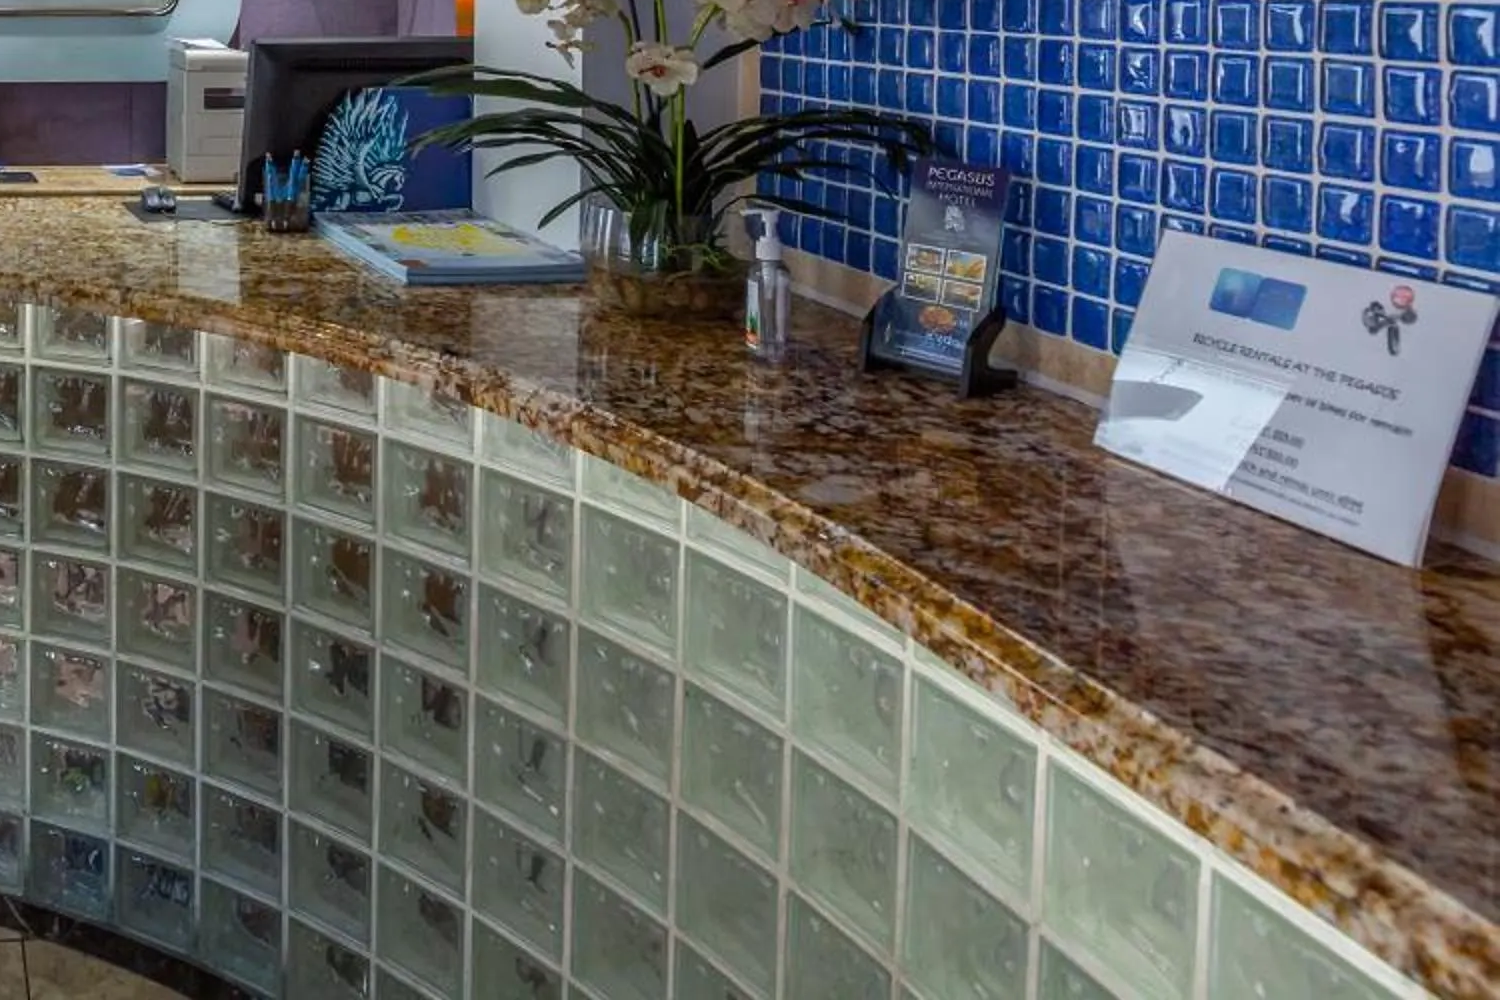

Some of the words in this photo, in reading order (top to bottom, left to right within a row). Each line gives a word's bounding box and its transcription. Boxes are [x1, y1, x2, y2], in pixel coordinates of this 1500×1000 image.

[928, 166, 995, 187] PEGASUS
[1192, 332, 1237, 353] BICYCLE
[1239, 344, 1292, 369] RENTALS
[1313, 366, 1337, 383] THE
[1339, 372, 1402, 400] PEGASUS
